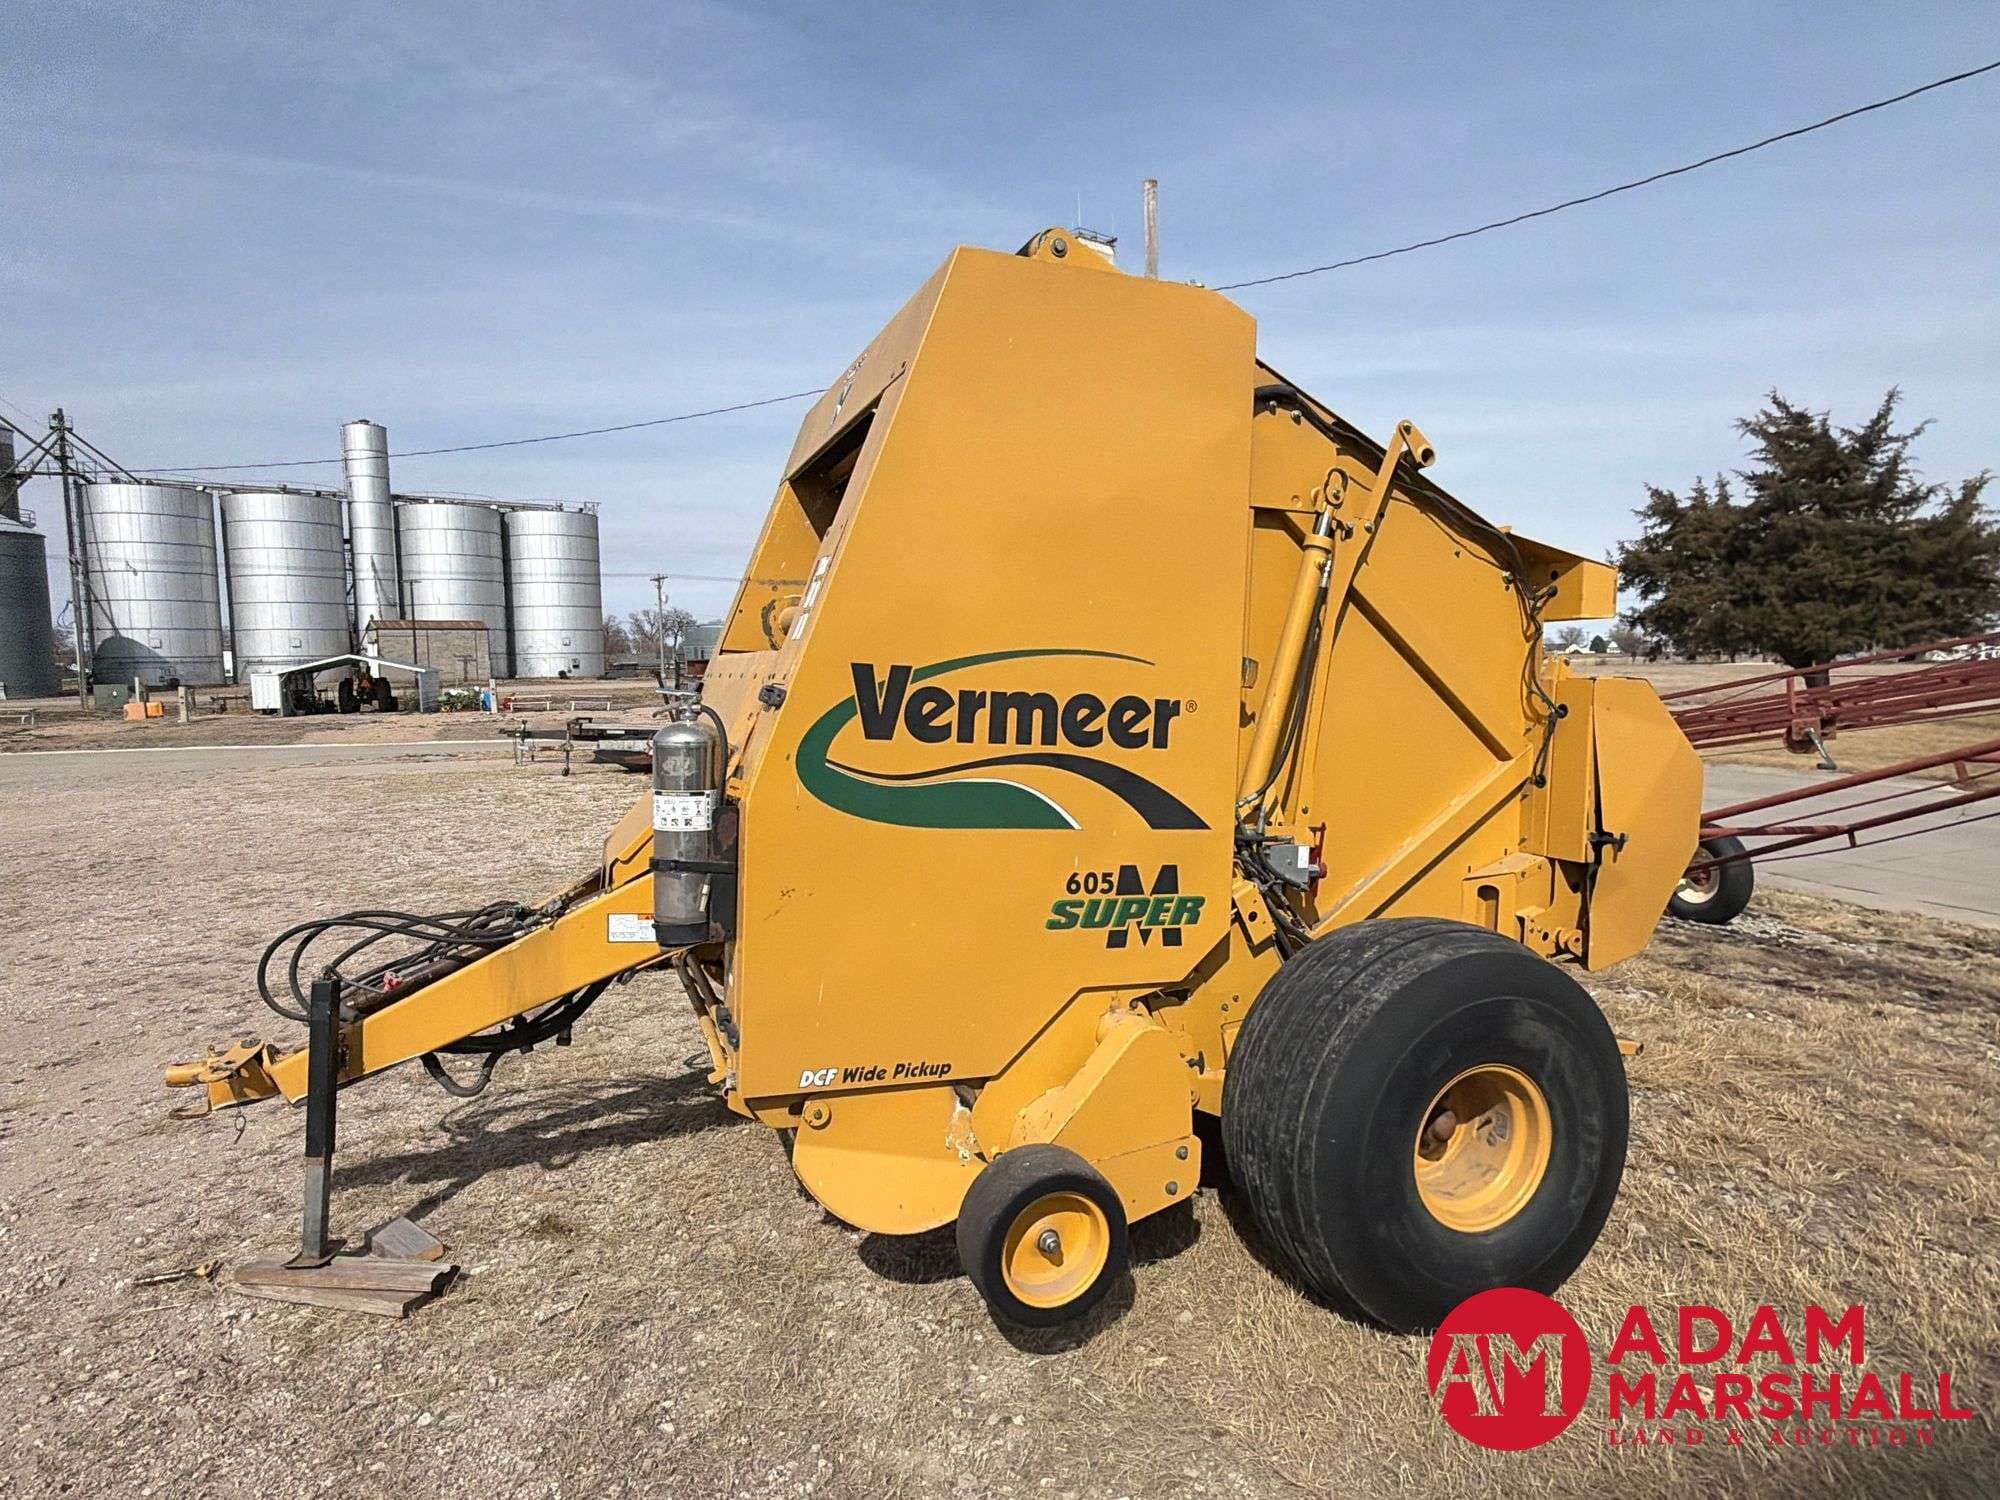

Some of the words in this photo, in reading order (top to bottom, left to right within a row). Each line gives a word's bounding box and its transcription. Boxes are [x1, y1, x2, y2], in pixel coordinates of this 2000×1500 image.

[1066, 871, 1114, 895] 605
[1045, 896, 1206, 930] SUPER
[798, 1067, 838, 1089] DCF
[842, 1065, 888, 1084] Wide
[892, 1061, 952, 1080] Pickup
